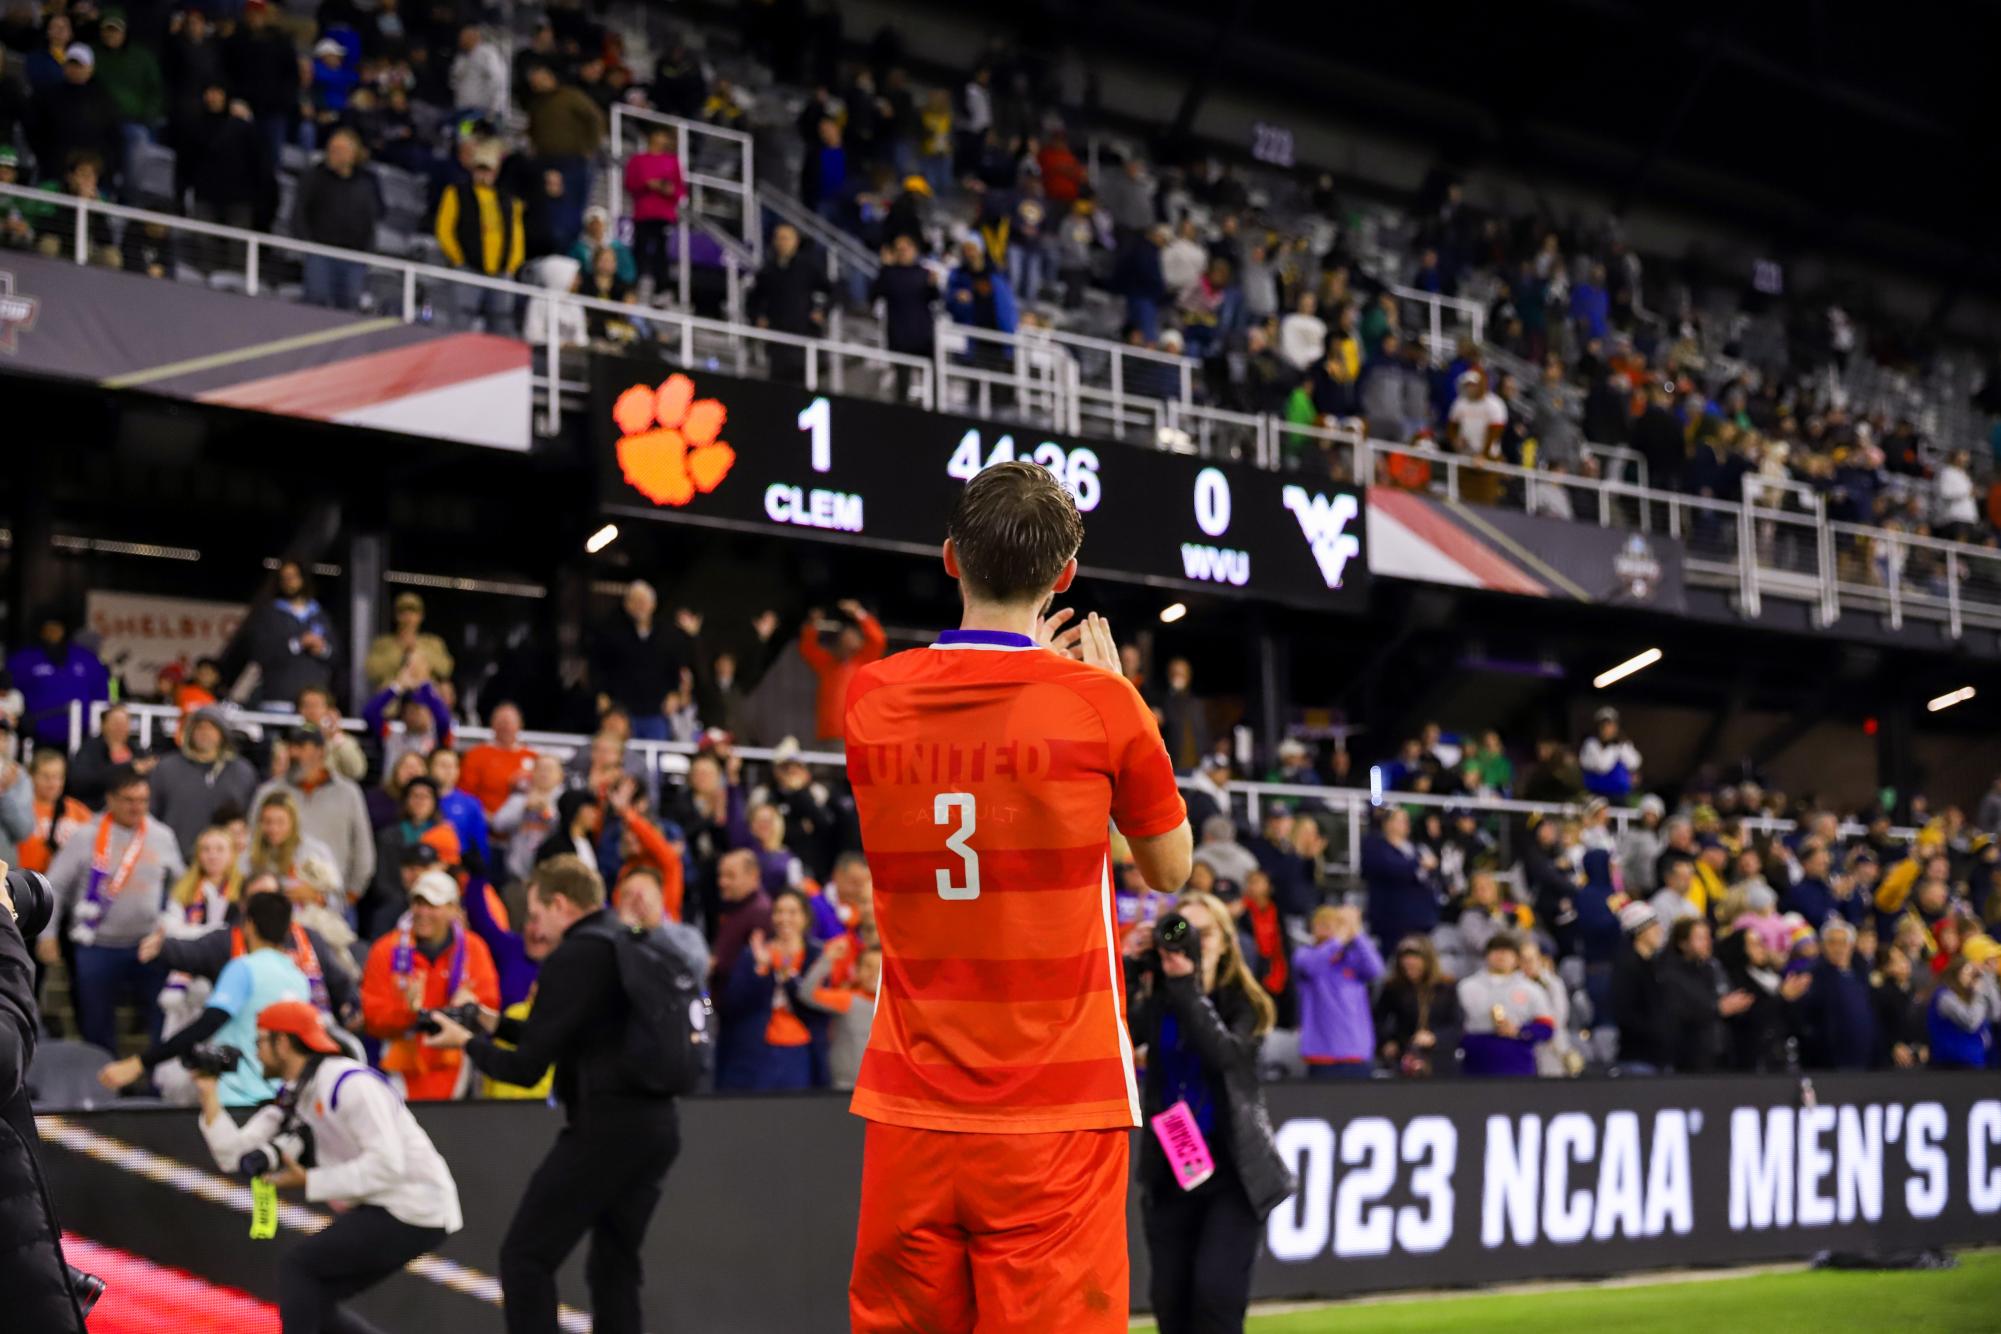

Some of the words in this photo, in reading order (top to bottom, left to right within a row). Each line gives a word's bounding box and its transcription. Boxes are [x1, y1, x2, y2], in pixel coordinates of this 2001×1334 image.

[798, 397, 831, 472] 1
[764, 483, 864, 532] CLEM
[1194, 467, 1231, 536] 0
[1181, 543, 1250, 586] WVU
[868, 739, 1050, 786] UNITED
[934, 793, 980, 900] 3
[1267, 1116, 1458, 1262] 023
[1482, 1109, 1694, 1249] NCAA
[1729, 1101, 1949, 1231] MEN'S
